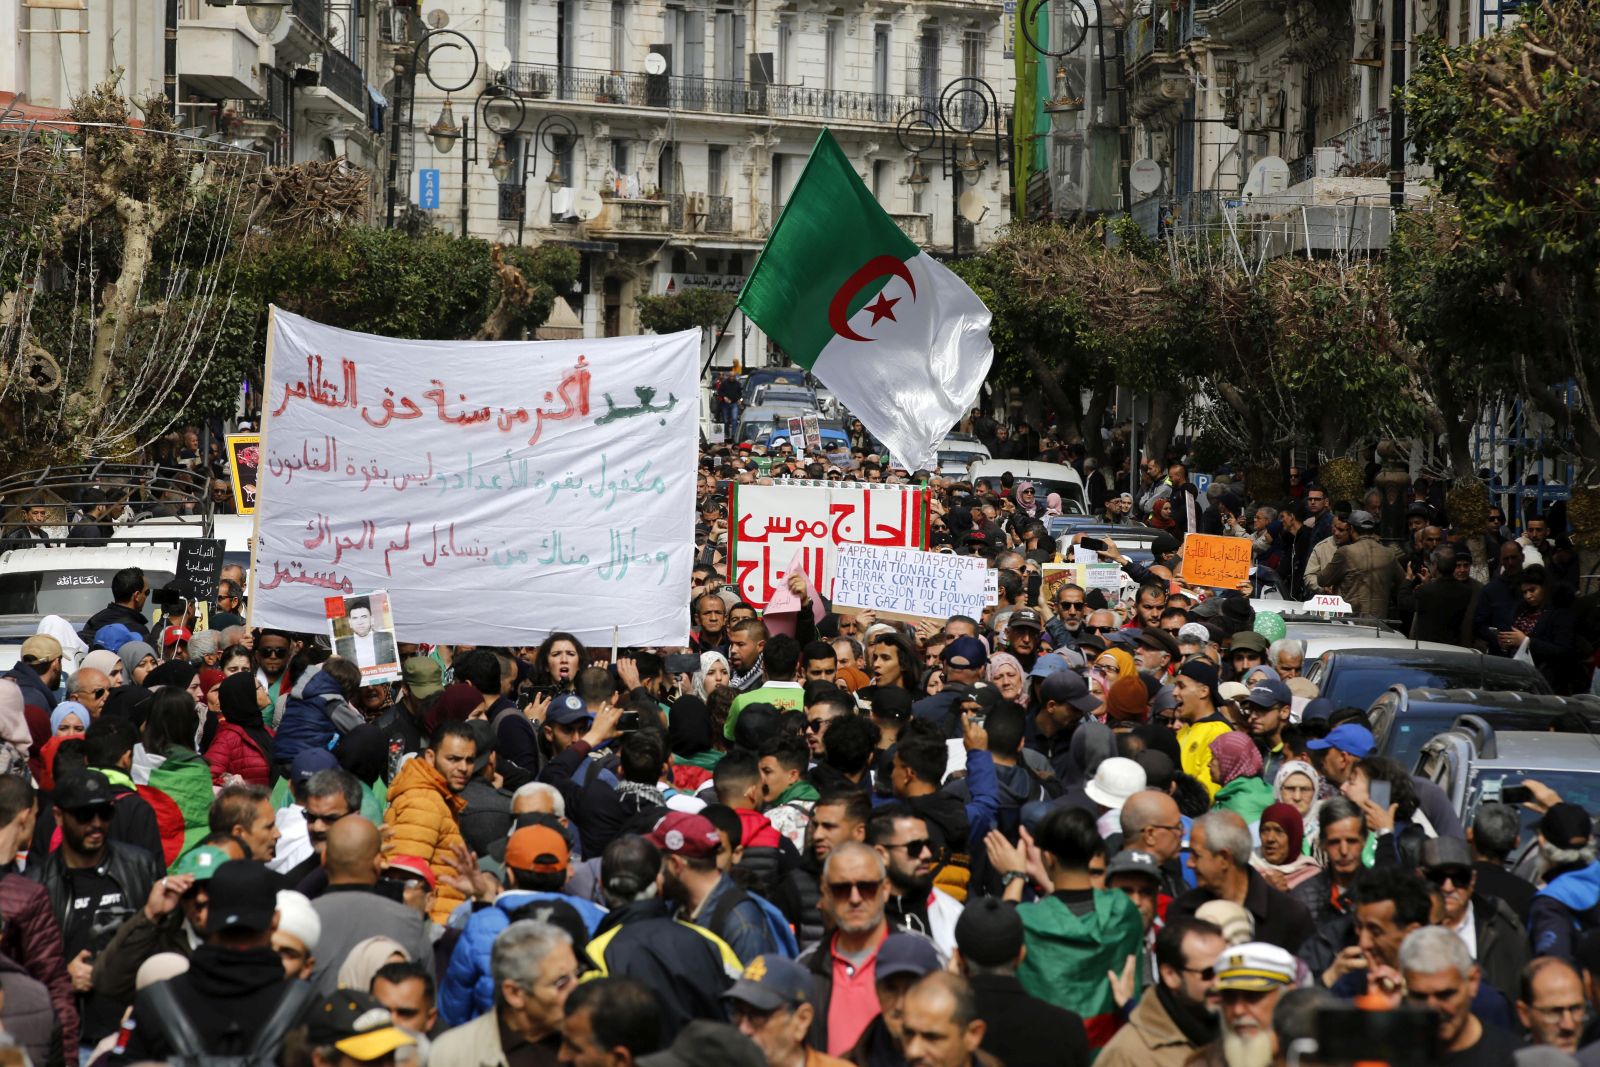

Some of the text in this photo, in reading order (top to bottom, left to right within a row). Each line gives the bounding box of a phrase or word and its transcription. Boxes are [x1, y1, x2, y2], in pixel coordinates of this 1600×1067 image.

[425, 171, 433, 206] CAAT
[272, 354, 679, 445] بعد أكثر من سنة حق التظاهر
[268, 435, 337, 485] القانون
[346, 458, 389, 492] بقوة
[451, 448, 528, 491] الأعداد
[533, 470, 583, 504] بقوة
[588, 453, 665, 511] مكفول
[1199, 477, 1208, 489] P
[830, 490, 922, 546] الحاج
[303, 512, 669, 586] ومازال هناك من يتساءل لم الحراك
[847, 546, 878, 559] APPEL
[895, 551, 907, 562] LA
[914, 553, 974, 570] DIASPORA
[258, 559, 353, 593] مستمر
[837, 568, 957, 591] LE HIRAK CONTRE LA
[839, 555, 962, 580] INTERNATIONALISER
[837, 592, 974, 617] ET LE GAZ DE SCHISTE
[842, 580, 986, 607] REPRESSION DU POUVOIR
[1316, 597, 1339, 606] TAXI
